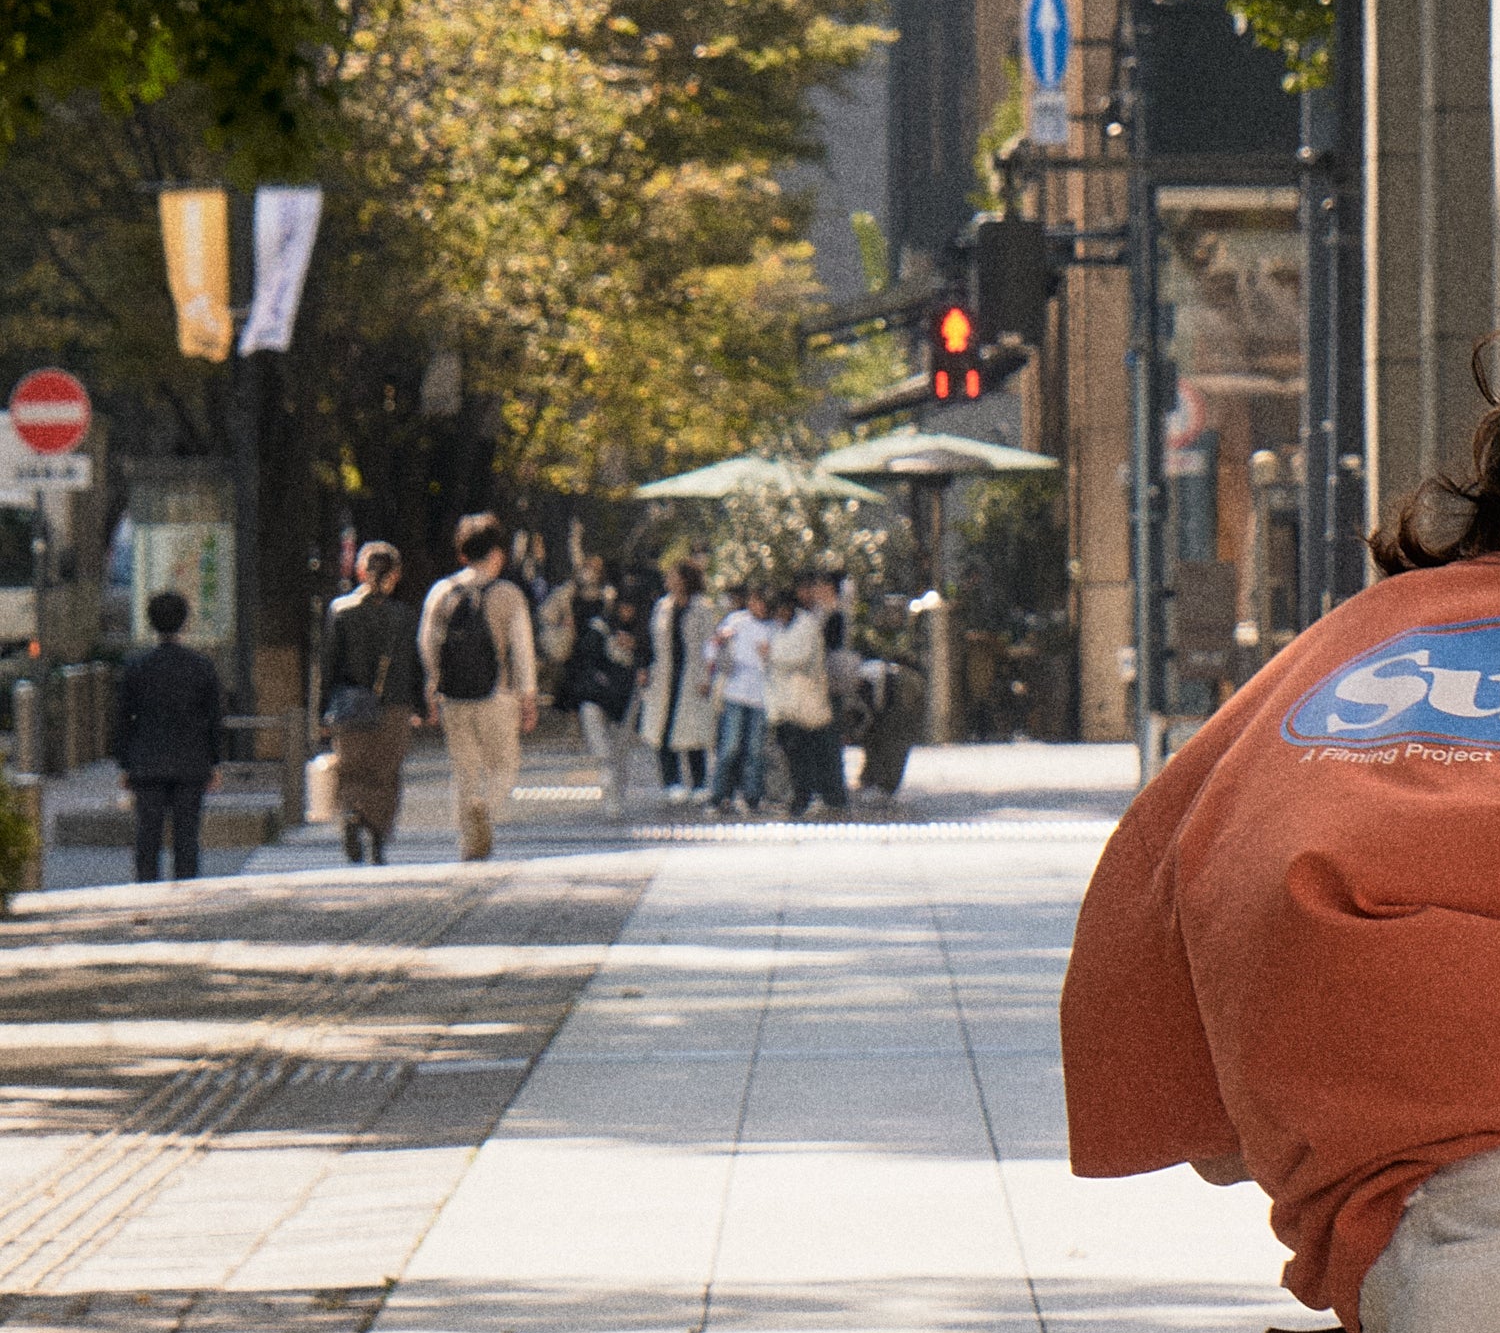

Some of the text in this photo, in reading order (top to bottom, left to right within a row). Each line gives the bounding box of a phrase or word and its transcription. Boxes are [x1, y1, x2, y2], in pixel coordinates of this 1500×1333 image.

[1299, 749, 1315, 764] A
[1318, 747, 1399, 766] Filming
[1405, 743, 1493, 766] Project
